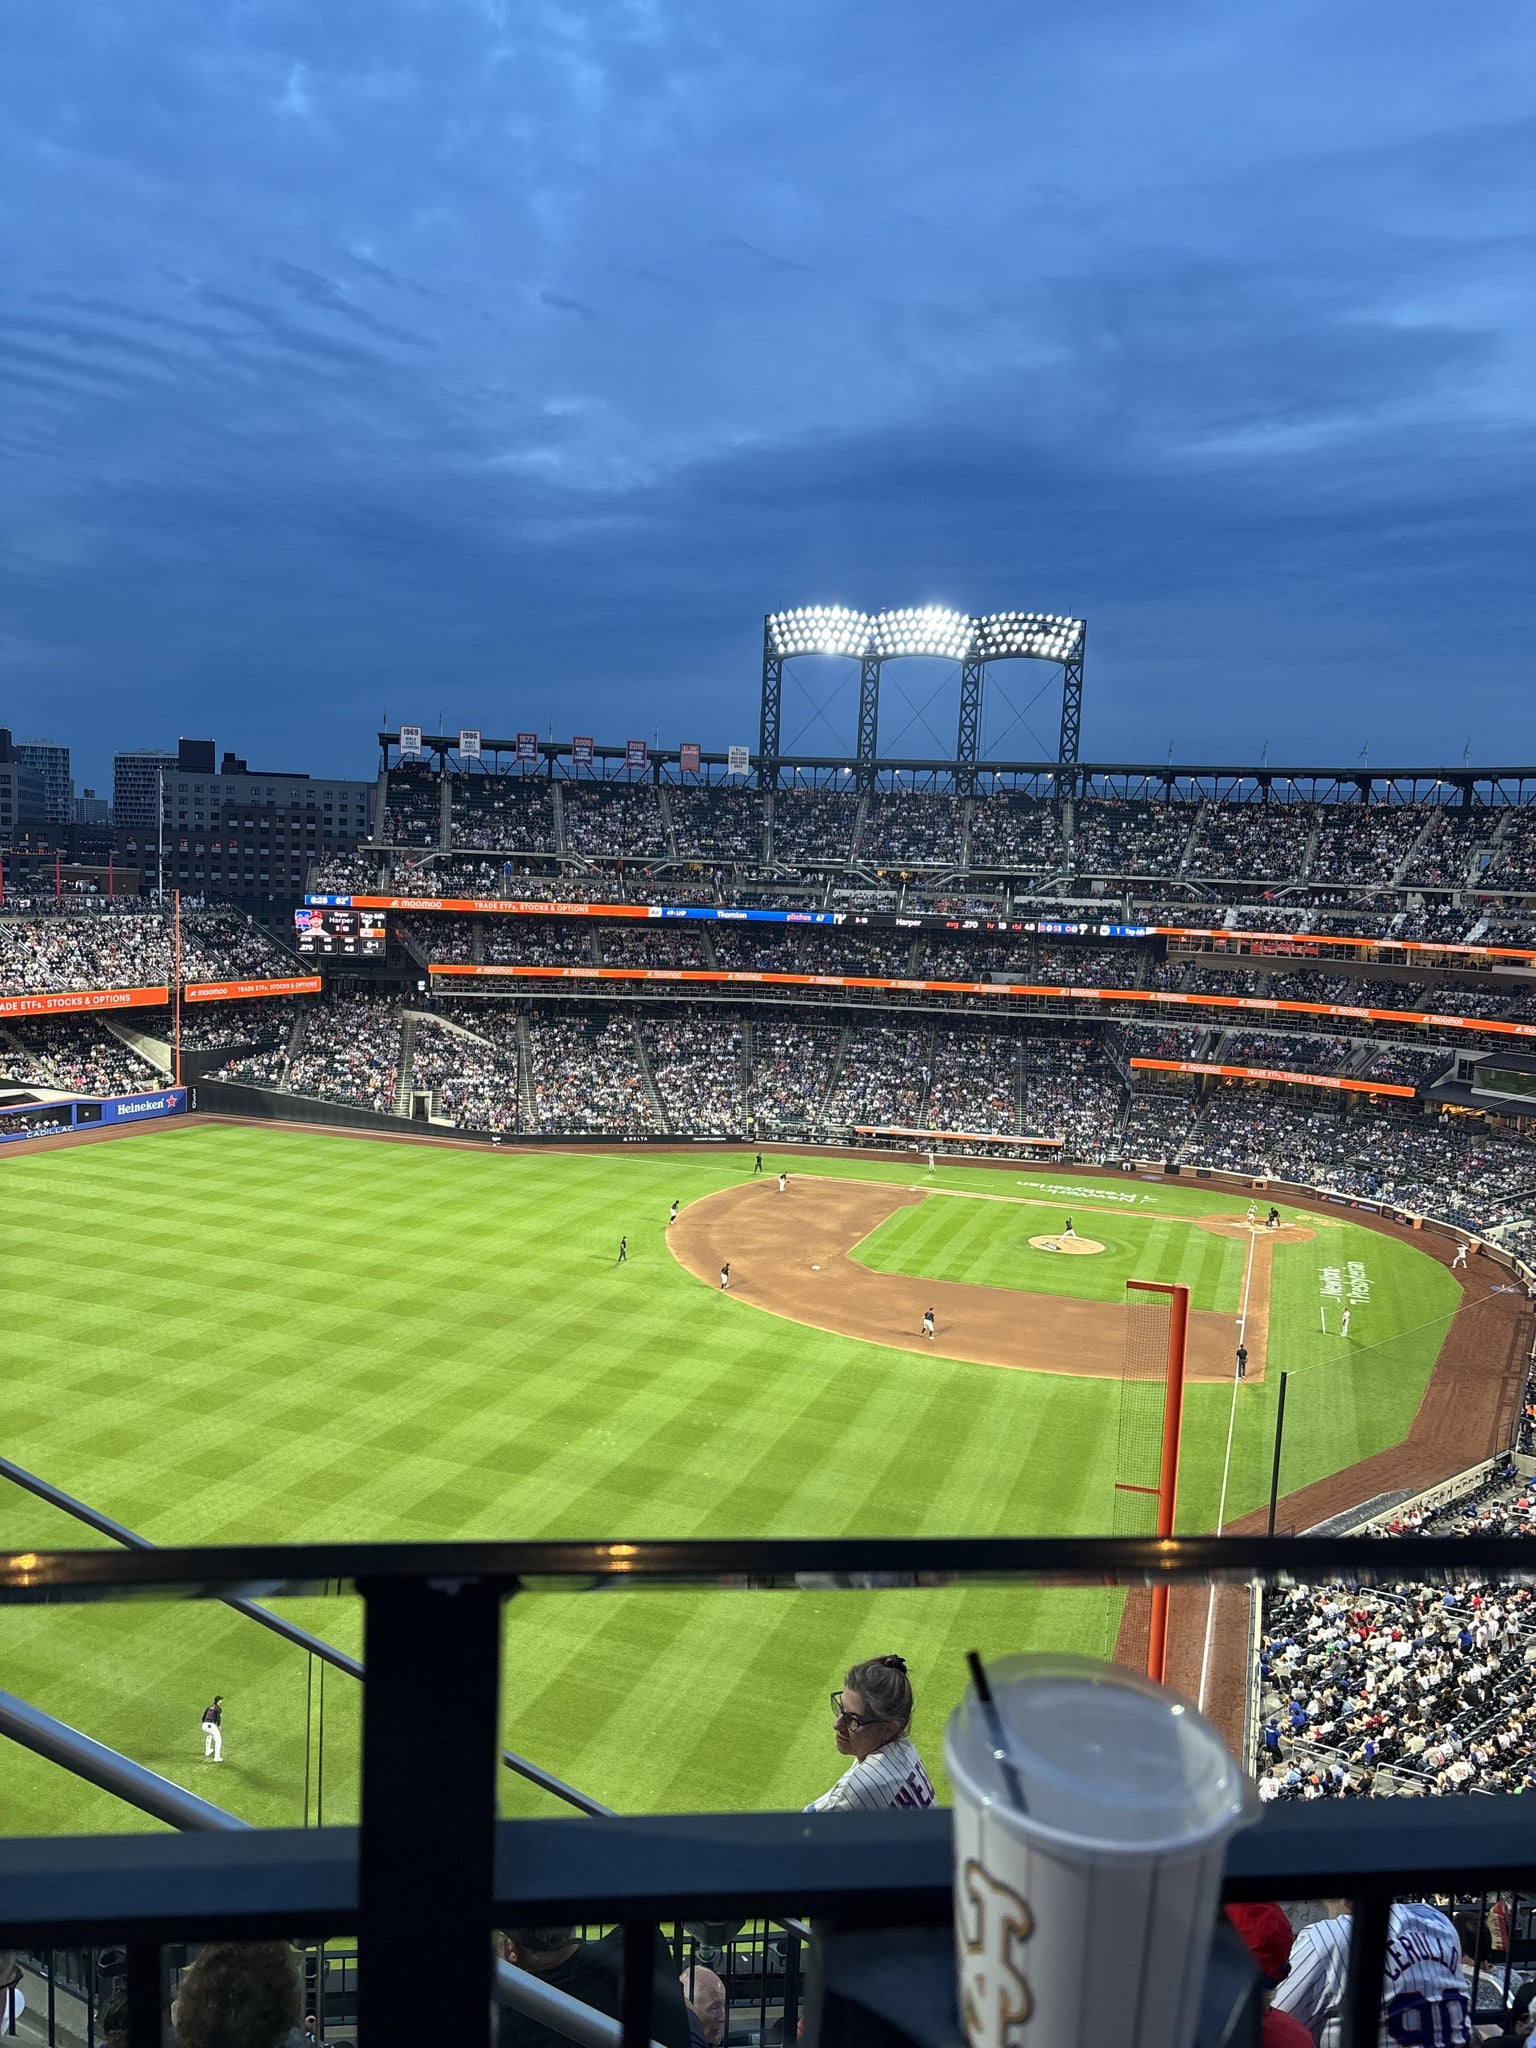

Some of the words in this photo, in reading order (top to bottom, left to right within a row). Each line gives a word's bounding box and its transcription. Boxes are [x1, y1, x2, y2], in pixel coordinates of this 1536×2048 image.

[403, 728, 419, 736] 1969
[401, 900, 443, 908] moomoo
[474, 902, 498, 910] TRADE
[500, 903, 518, 911] ETFs,
[520, 904, 549, 912] STOCKS
[557, 905, 589, 913] OPTIONS
[717, 911, 748, 919] Thornton
[787, 913, 811, 922] pitches
[329, 917, 354, 925] Harper
[896, 918, 921, 927] Harper
[946, 922, 959, 930] avg
[962, 921, 978, 929] .270
[986, 921, 995, 929] hr
[998, 921, 1007, 930] 18
[1024, 923, 1036, 931] 48
[237, 985, 255, 993] TRADE
[269, 982, 290, 992] STOCKS
[296, 980, 318, 989] OPTIONS
[198, 987, 228, 997] moomoo
[21, 1000, 45, 1010] ETFs,
[47, 996, 83, 1008] STOCKS
[85, 996, 91, 1005] &
[93, 993, 131, 1005] OPTIONS
[1246, 999, 1278, 1008] moomoo
[1337, 1006, 1369, 1016] moomoo
[1431, 1015, 1464, 1025] moomoo
[1188, 1065, 1221, 1074] moomoo
[1247, 1069, 1266, 1078] TRADE
[1284, 1073, 1307, 1083] STOCKS
[1313, 1077, 1341, 1087] OPTIONS
[118, 1099, 164, 1115] Heineken
[26, 1125, 75, 1139] CADILLAC
